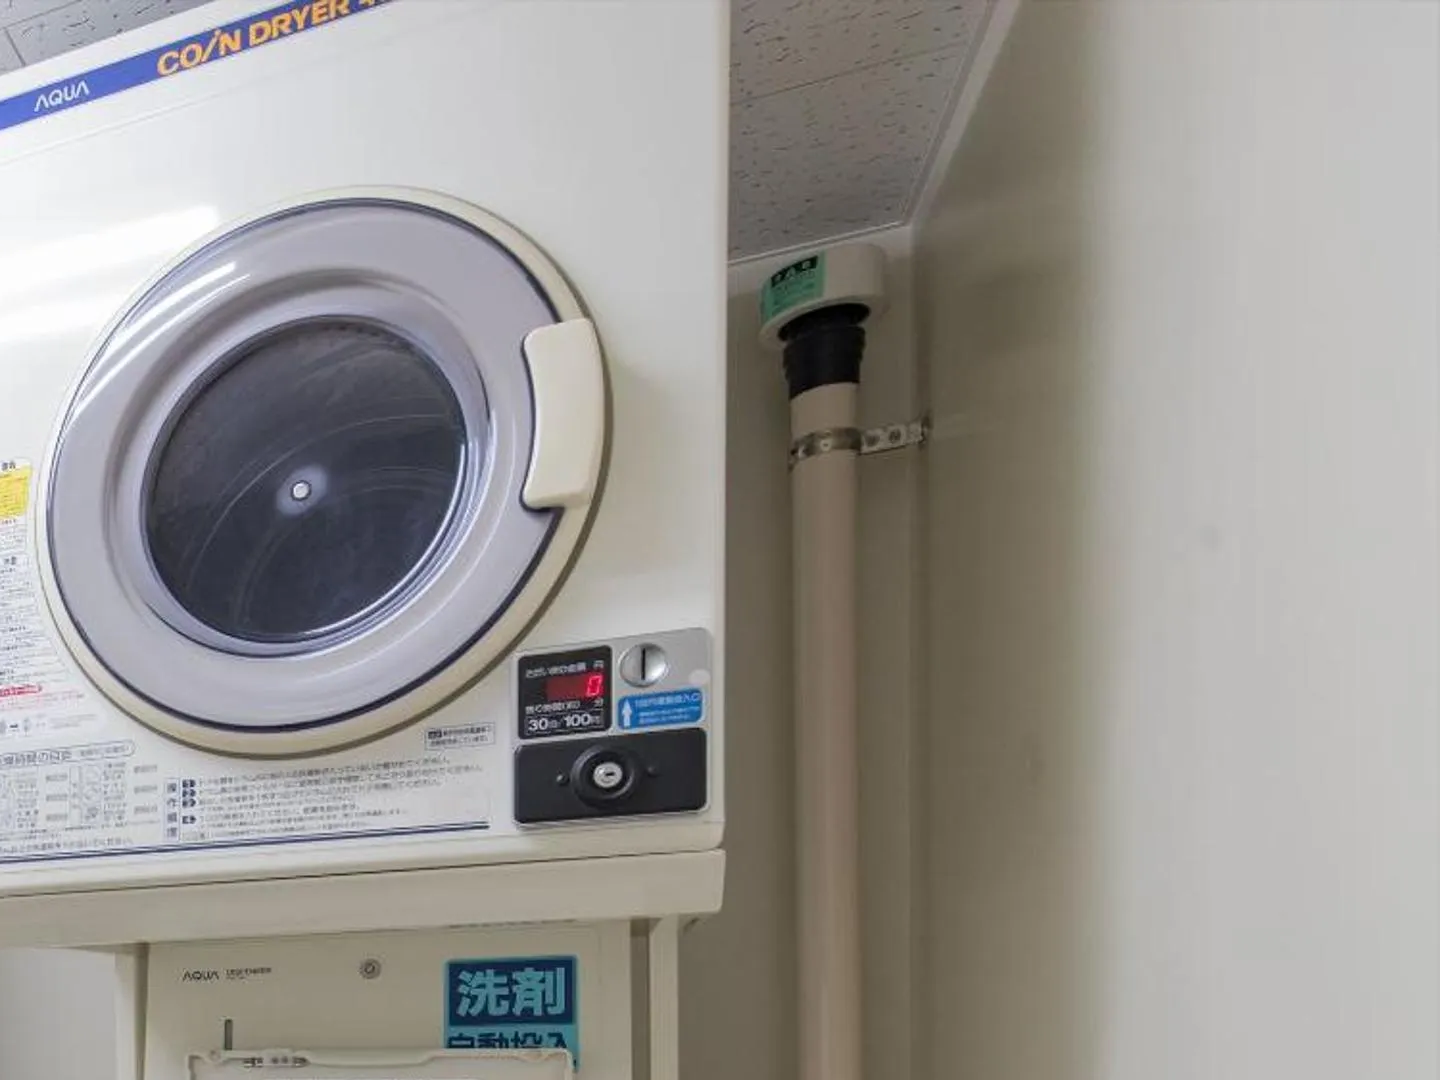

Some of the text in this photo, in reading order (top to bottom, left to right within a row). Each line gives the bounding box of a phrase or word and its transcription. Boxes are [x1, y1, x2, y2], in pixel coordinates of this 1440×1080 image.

[249, 0, 350, 46] DRYER
[34, 80, 89, 112] AQUA
[587, 675, 603, 697] 0
[182, 970, 220, 981] AQUA
[456, 967, 565, 1017] 洗剤
